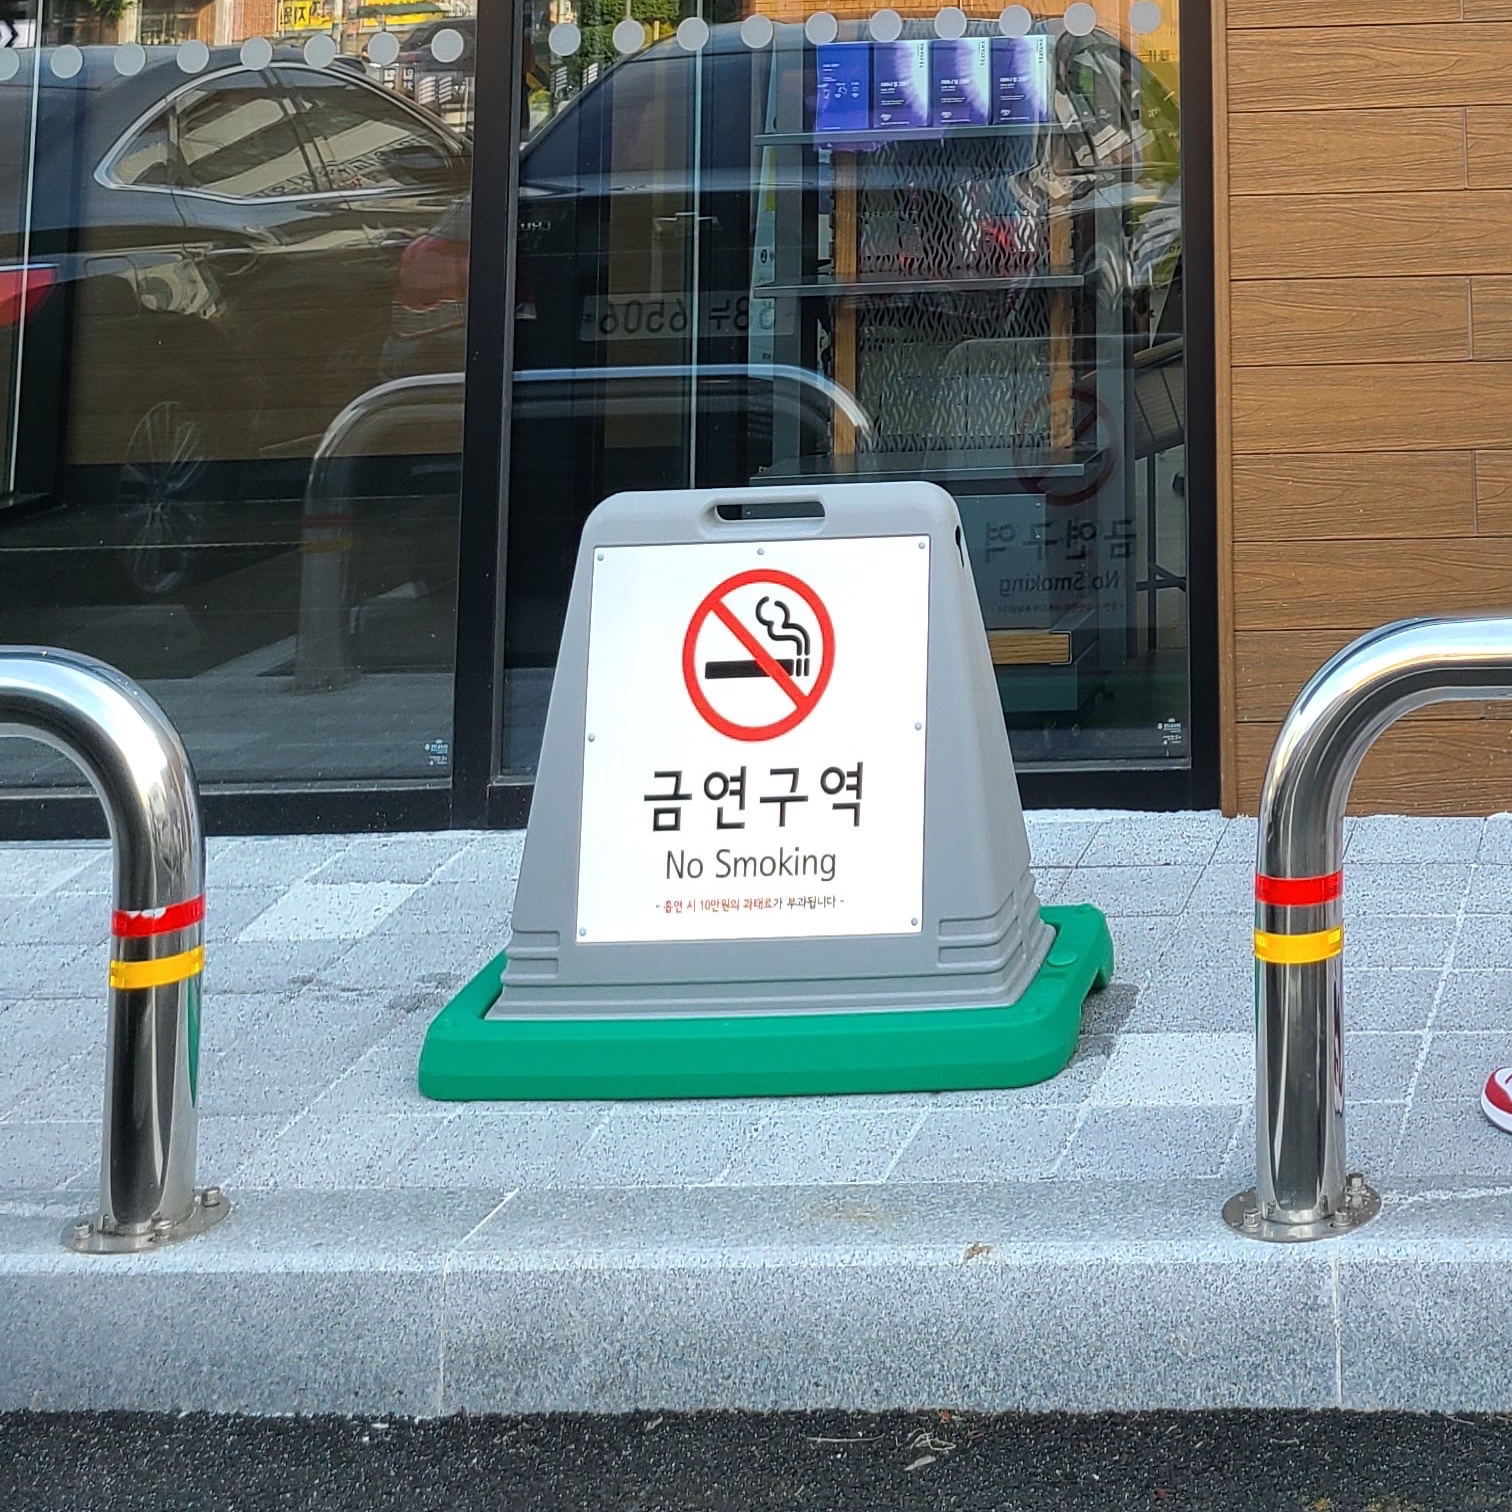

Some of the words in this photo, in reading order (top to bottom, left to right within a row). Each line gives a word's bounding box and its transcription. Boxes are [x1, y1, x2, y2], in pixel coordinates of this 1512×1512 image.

[643, 761, 864, 832] 금연구역
[665, 849, 704, 880] No
[715, 846, 837, 882] Smoking
[686, 898, 696, 913] 시
[786, 895, 837, 911] 부과됩니다
